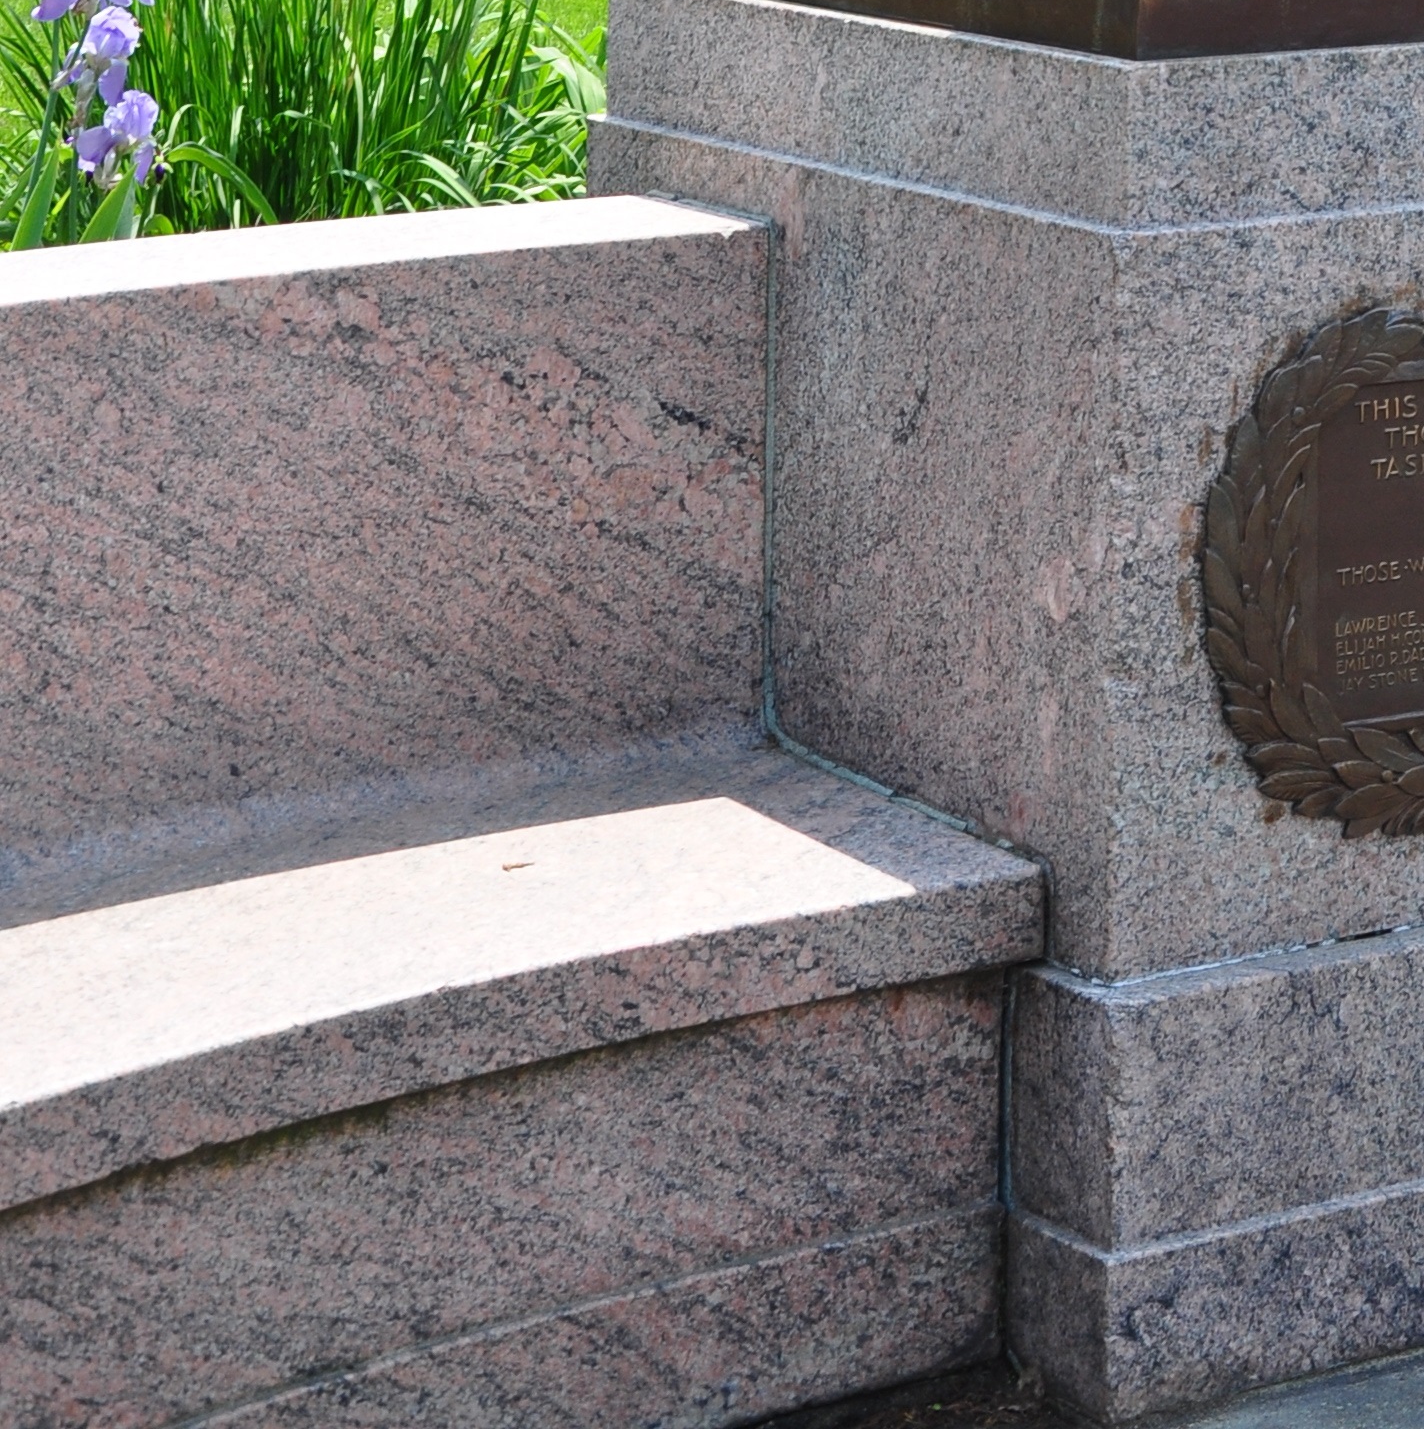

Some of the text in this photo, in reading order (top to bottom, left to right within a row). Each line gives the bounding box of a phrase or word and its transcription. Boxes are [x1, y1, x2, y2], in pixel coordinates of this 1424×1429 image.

[1354, 395, 1418, 423] THIS
[1336, 561, 1402, 587] THOSE
[1335, 610, 1418, 638] LAWRENCE
[1336, 634, 1387, 657] ELIJAH
[1336, 653, 1386, 675] EMILIO
[1337, 676, 1364, 697] JAY
[1368, 667, 1419, 690] STONE
